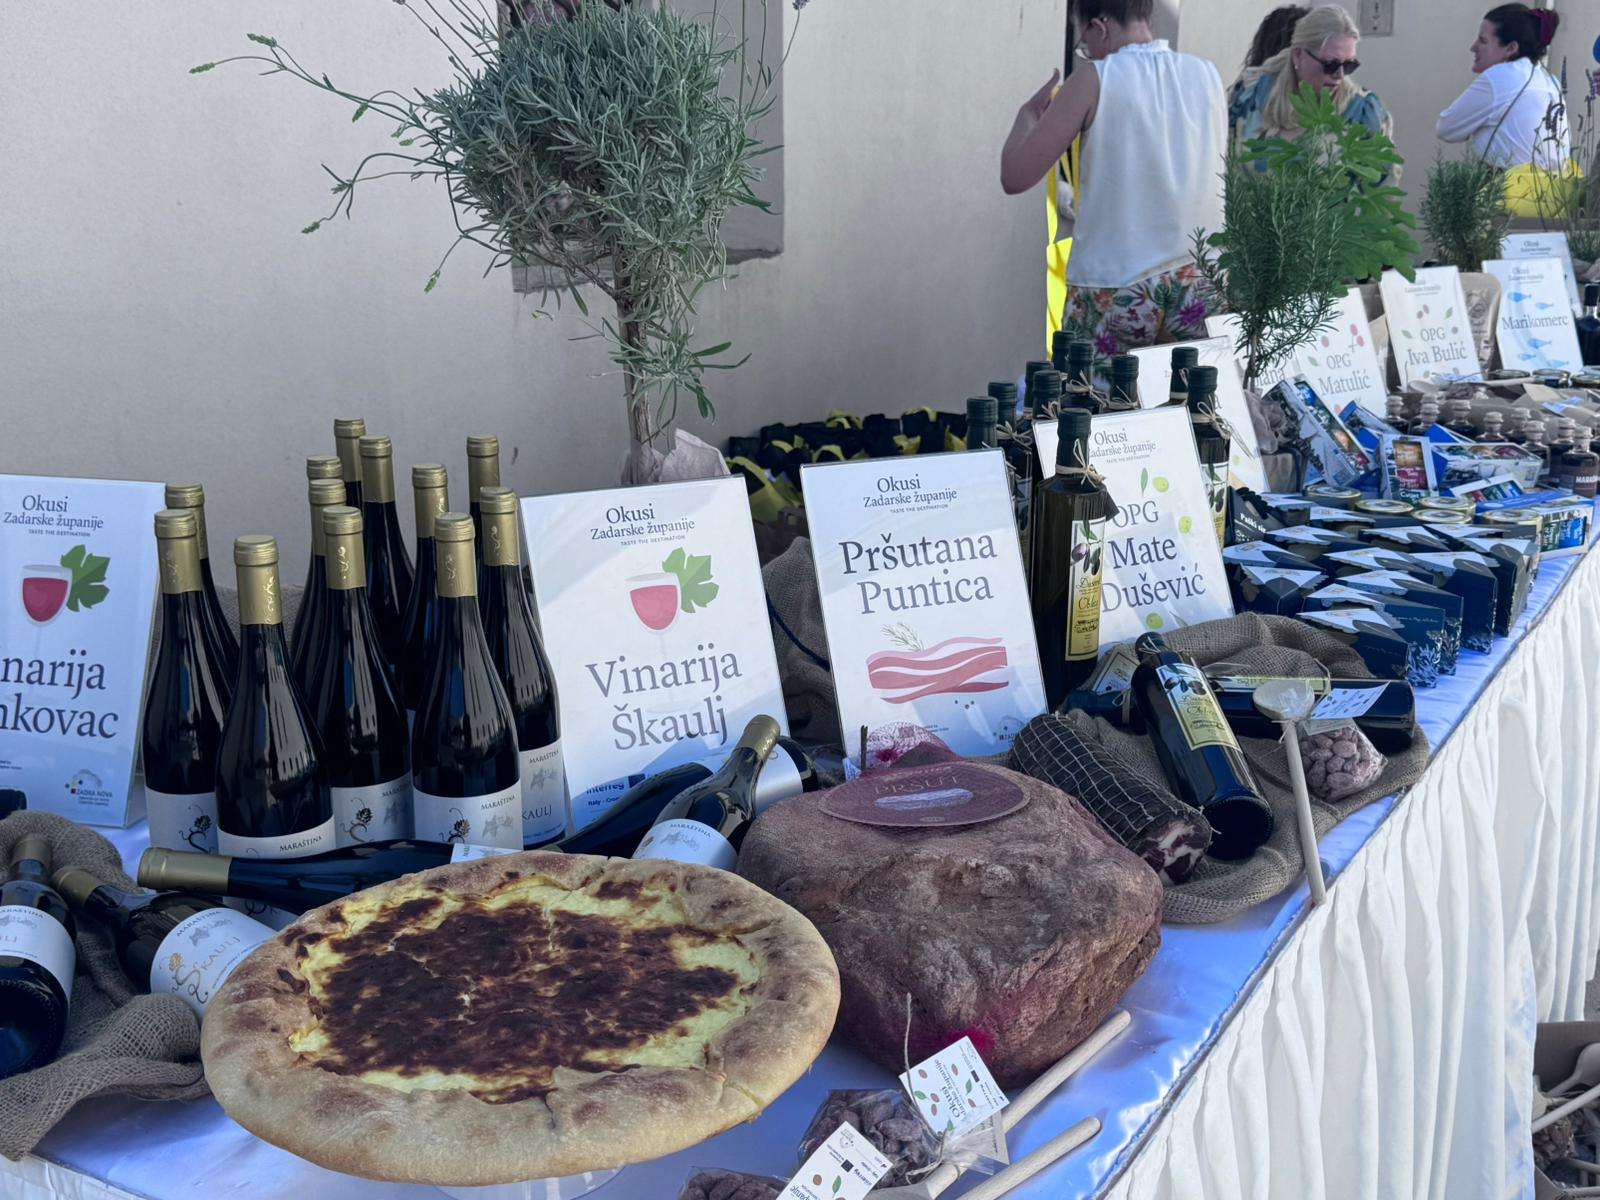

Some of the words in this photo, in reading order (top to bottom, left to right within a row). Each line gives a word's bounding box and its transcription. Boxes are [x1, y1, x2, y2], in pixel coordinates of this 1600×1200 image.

[1501, 313, 1569, 331] Marikomerc
[1419, 326, 1446, 342] OPG
[1326, 353, 1351, 370] OPG
[1406, 349, 1430, 366] Iva
[1431, 340, 1468, 363] Bulić
[1318, 369, 1371, 396] Matulić
[1093, 427, 1128, 445] Okusi
[877, 473, 921, 493] Okusi
[22, 494, 69, 513] Okusi
[863, 492, 912, 508] Zadarske
[913, 487, 957, 505] županije
[4, 511, 54, 527] Zadarske
[56, 514, 104, 532] županije
[605, 502, 656, 524] Okusi
[1112, 500, 1159, 528] OPG
[590, 523, 645, 540] Zadarske
[647, 517, 696, 536] županije
[838, 532, 998, 575] Pršutana
[1107, 536, 1177, 571] Mate
[856, 568, 995, 615] Puntica
[1100, 561, 1206, 613] Dušević
[0, 648, 106, 700] narija
[585, 642, 743, 698] Vinarija
[612, 694, 728, 750] Škaulj
[521, 805, 552, 821] KAULJ
[279, 836, 322, 853] MARAŠTINA
[941, 1086, 960, 1118] Okusi
